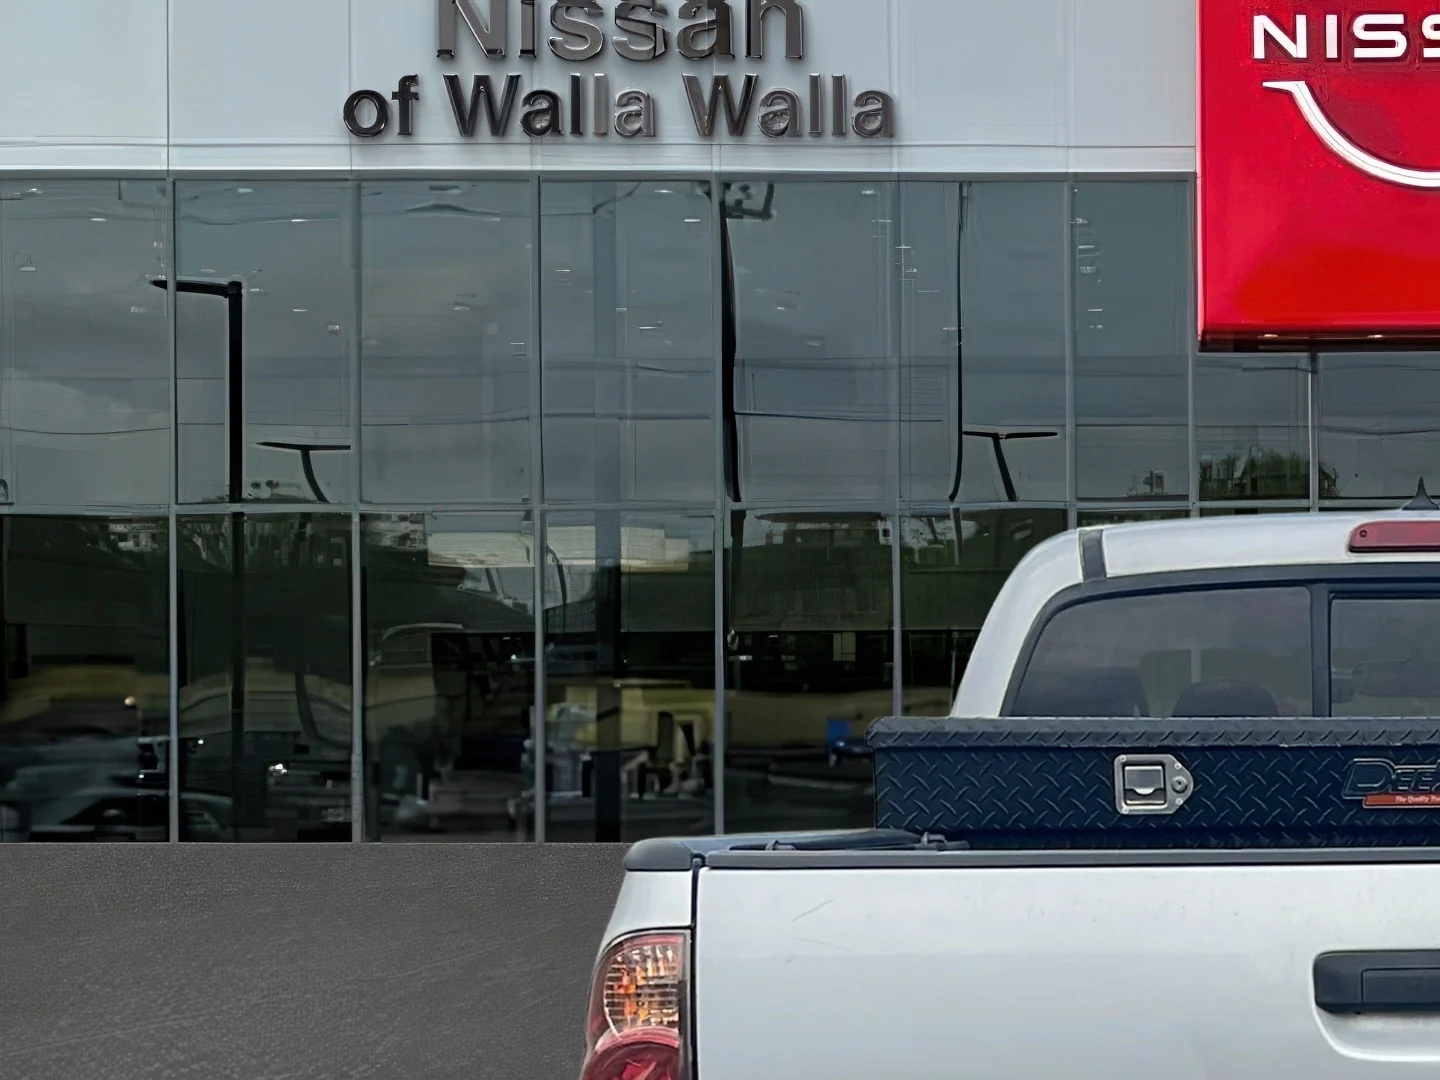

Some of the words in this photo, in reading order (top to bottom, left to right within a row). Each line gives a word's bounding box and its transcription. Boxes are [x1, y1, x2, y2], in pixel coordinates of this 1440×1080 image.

[437, 0, 804, 60] Nissan
[343, 74, 420, 137] of
[443, 72, 656, 138] Walla
[681, 72, 895, 138] Walla
